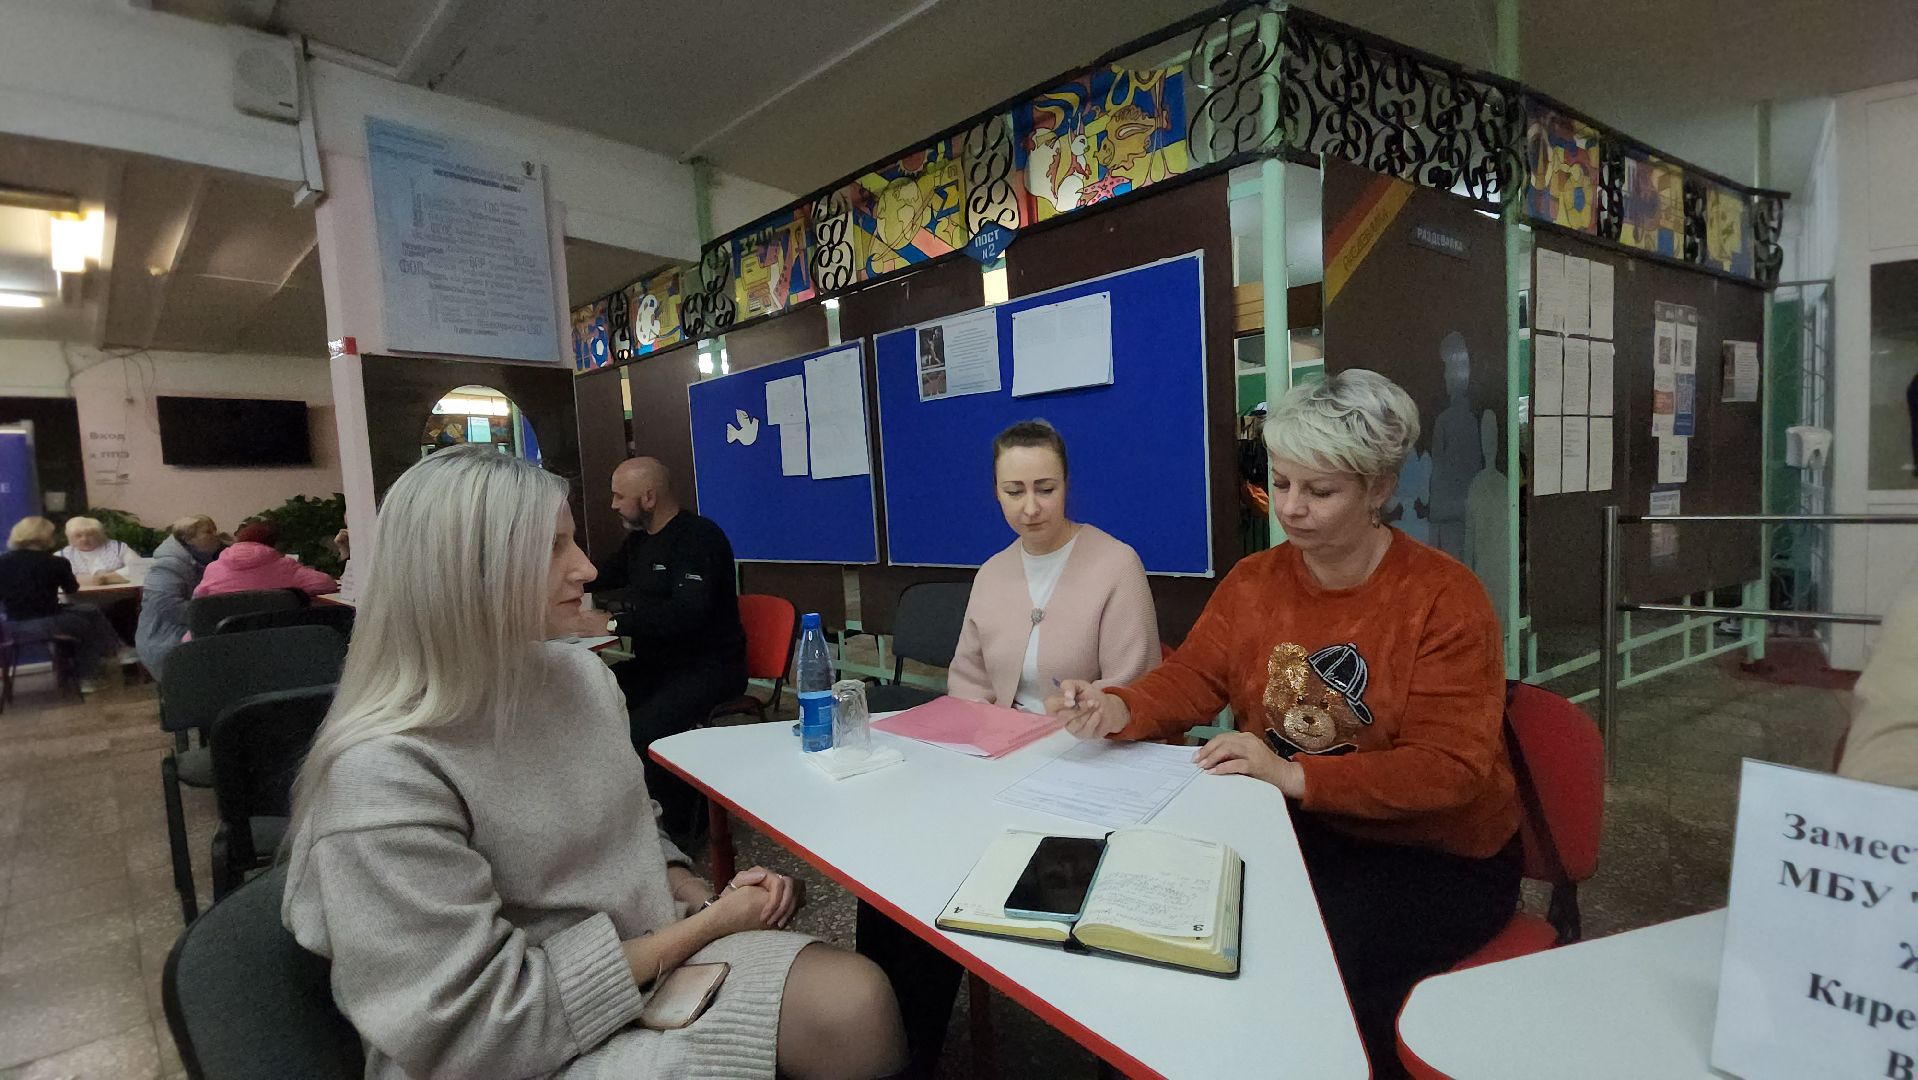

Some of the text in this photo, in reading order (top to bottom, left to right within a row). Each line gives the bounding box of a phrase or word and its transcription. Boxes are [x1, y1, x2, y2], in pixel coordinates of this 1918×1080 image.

[975, 229, 1000, 247] ПОСТ
[1416, 227, 1464, 252] РАЗДЕВАЛКА
[89, 432, 126, 441] Вход
[1782, 812, 1918, 864] Замес
[1778, 859, 1893, 909] МБУ
[1807, 971, 1917, 1031] Кире
